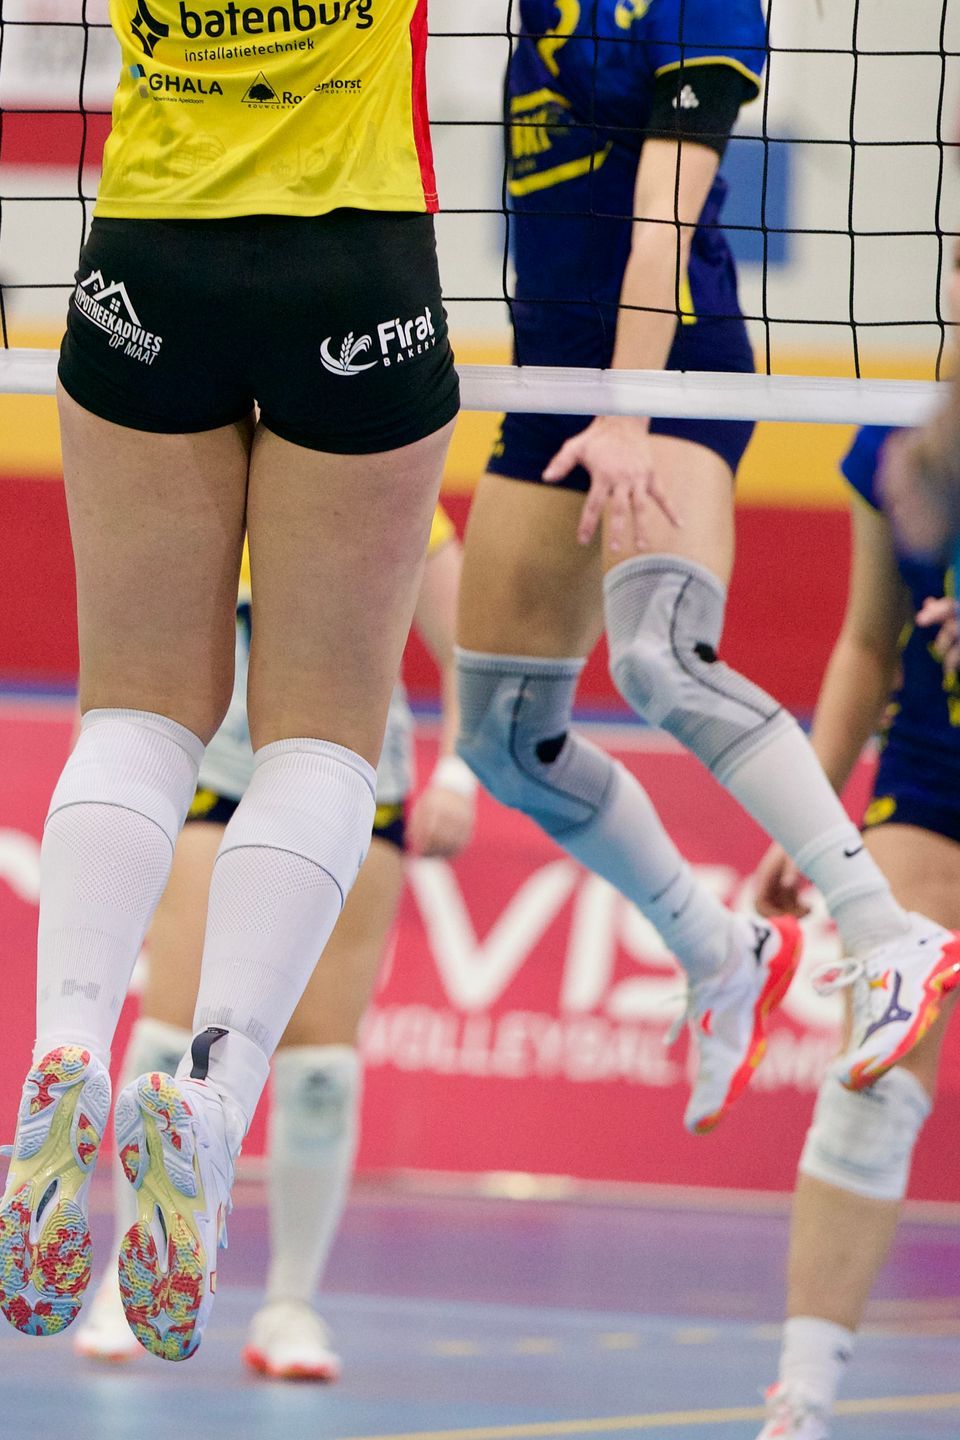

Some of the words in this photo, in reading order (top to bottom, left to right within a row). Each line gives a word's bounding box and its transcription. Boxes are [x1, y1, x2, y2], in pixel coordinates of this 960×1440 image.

[184, 38, 315, 62] installatietechniek
[149, 73, 224, 96] GHALA
[75, 283, 163, 353] HYPOTHEEKADVIES
[376, 306, 435, 355] Firat
[108, 333, 125, 349] OP
[124, 341, 159, 366] MAAT
[384, 337, 436, 368] BAKERY
